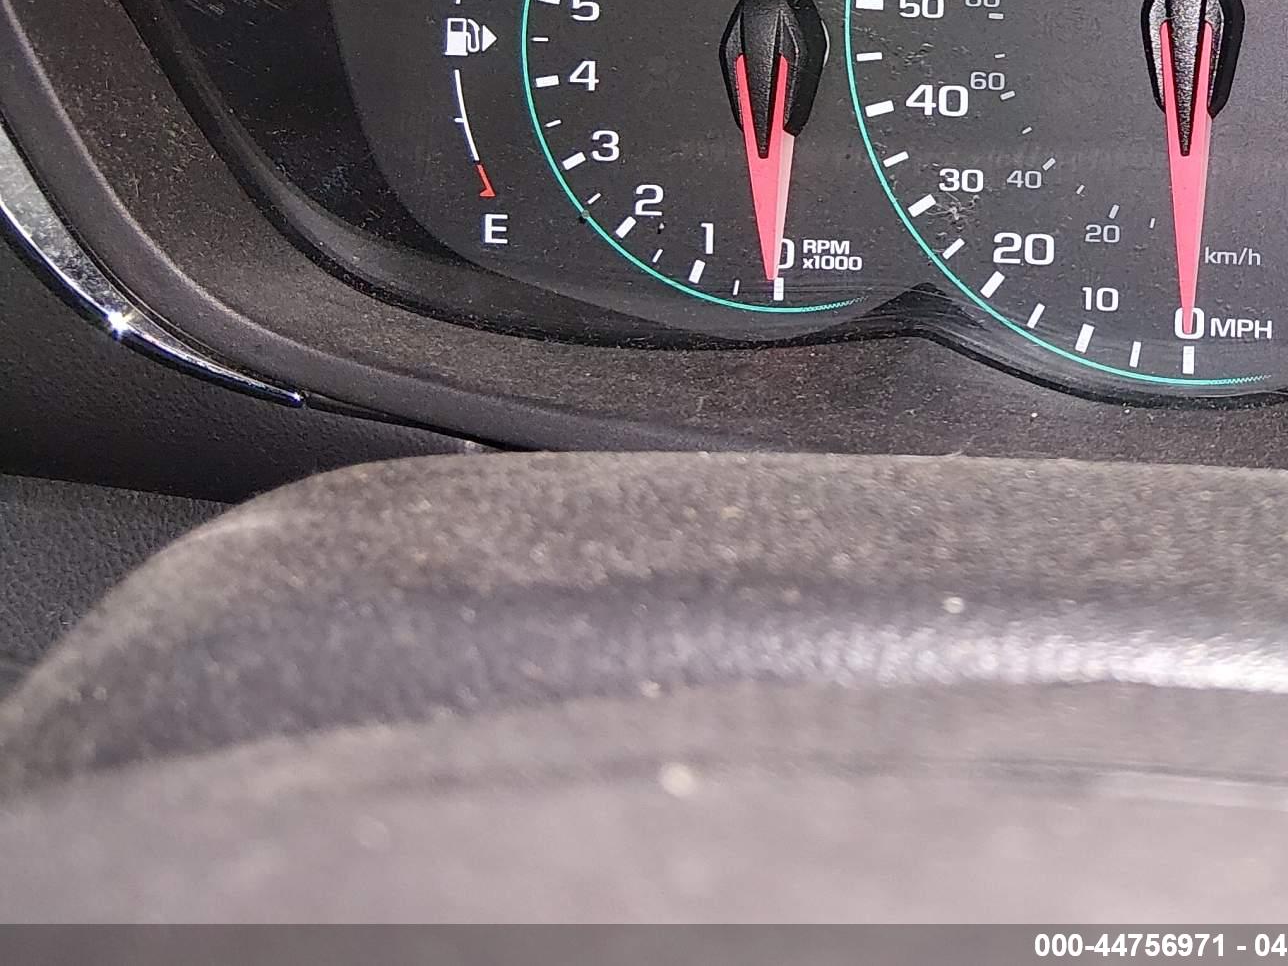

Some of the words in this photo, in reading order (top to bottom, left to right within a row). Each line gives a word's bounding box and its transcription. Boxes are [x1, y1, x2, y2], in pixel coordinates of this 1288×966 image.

[570, 61, 599, 90] 4
[971, 73, 1005, 90] 60
[906, 85, 968, 116] 40
[592, 131, 619, 161] 3
[939, 169, 983, 192] 30
[1007, 170, 1041, 188] 40
[635, 185, 663, 215] 2
[485, 214, 507, 243] E
[701, 223, 713, 254] 1
[1085, 225, 1120, 242] 20
[803, 240, 849, 254] RPM
[993, 233, 1054, 265] 20
[1205, 247, 1260, 265] km/h
[803, 255, 862, 270] x1000
[1083, 287, 1118, 311] 10
[1174, 307, 1204, 339] 0
[1211, 319, 1272, 339] MPH
